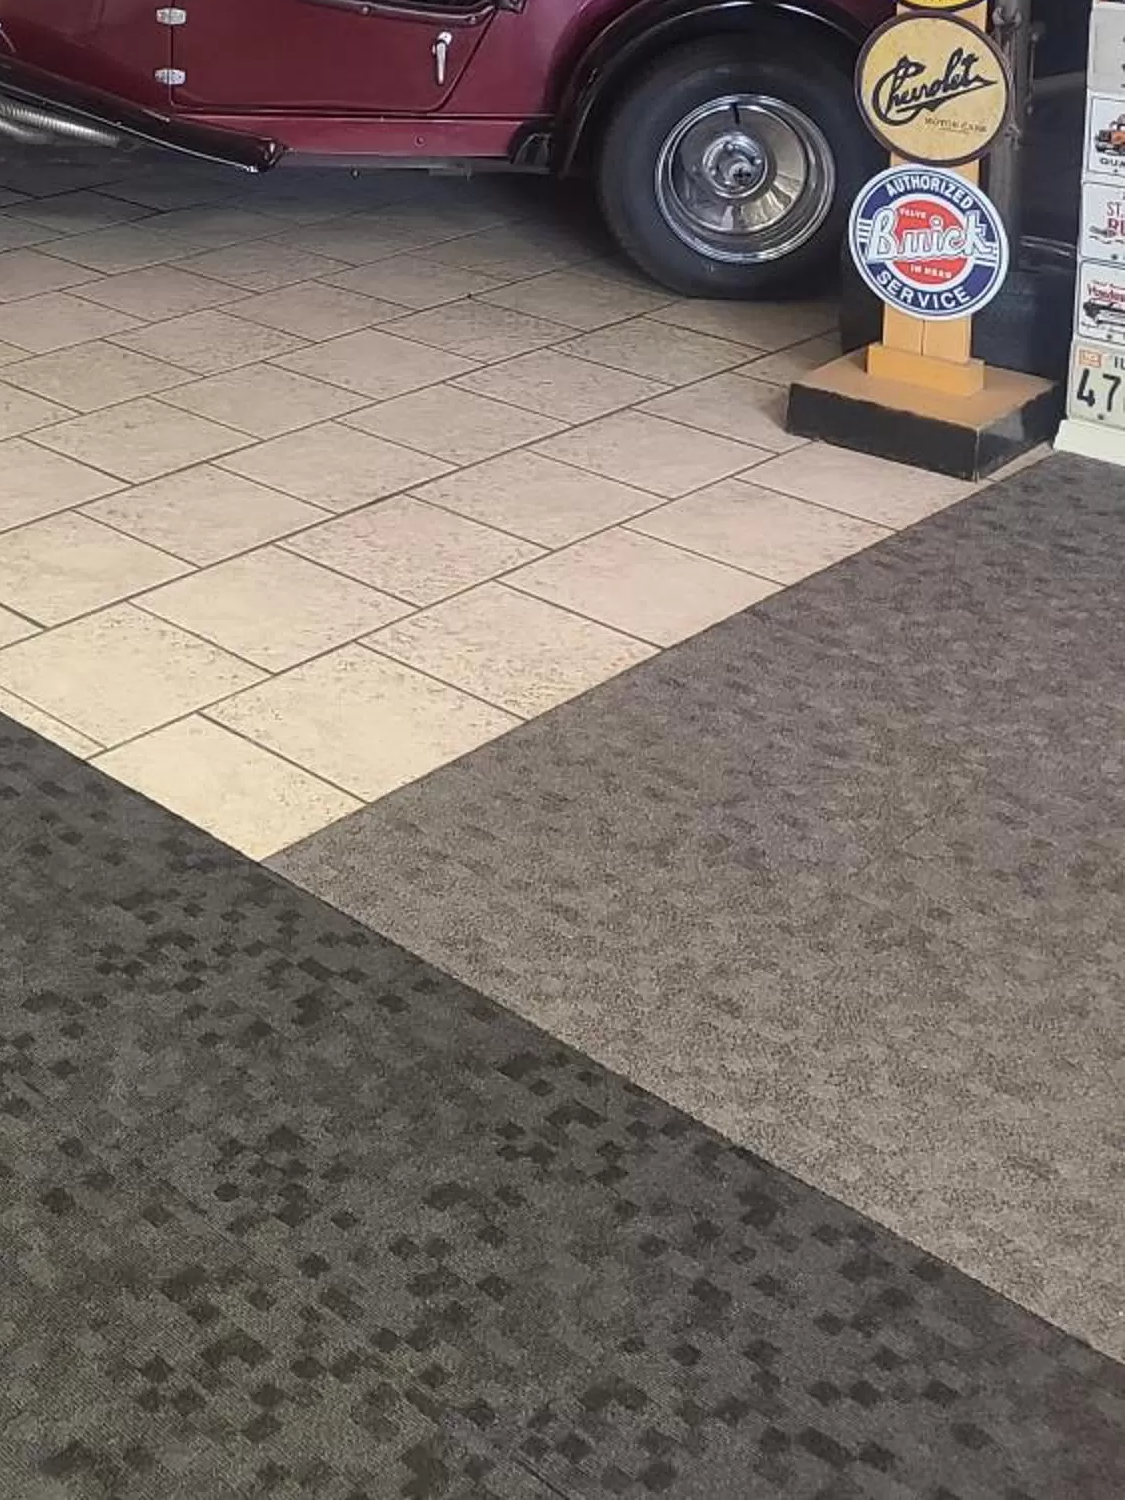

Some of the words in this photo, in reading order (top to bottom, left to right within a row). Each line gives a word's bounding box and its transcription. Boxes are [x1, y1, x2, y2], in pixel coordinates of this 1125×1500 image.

[884, 175, 974, 209] AUTHORIZED
[865, 206, 994, 264] Buick
[876, 270, 970, 310] SERVICE
